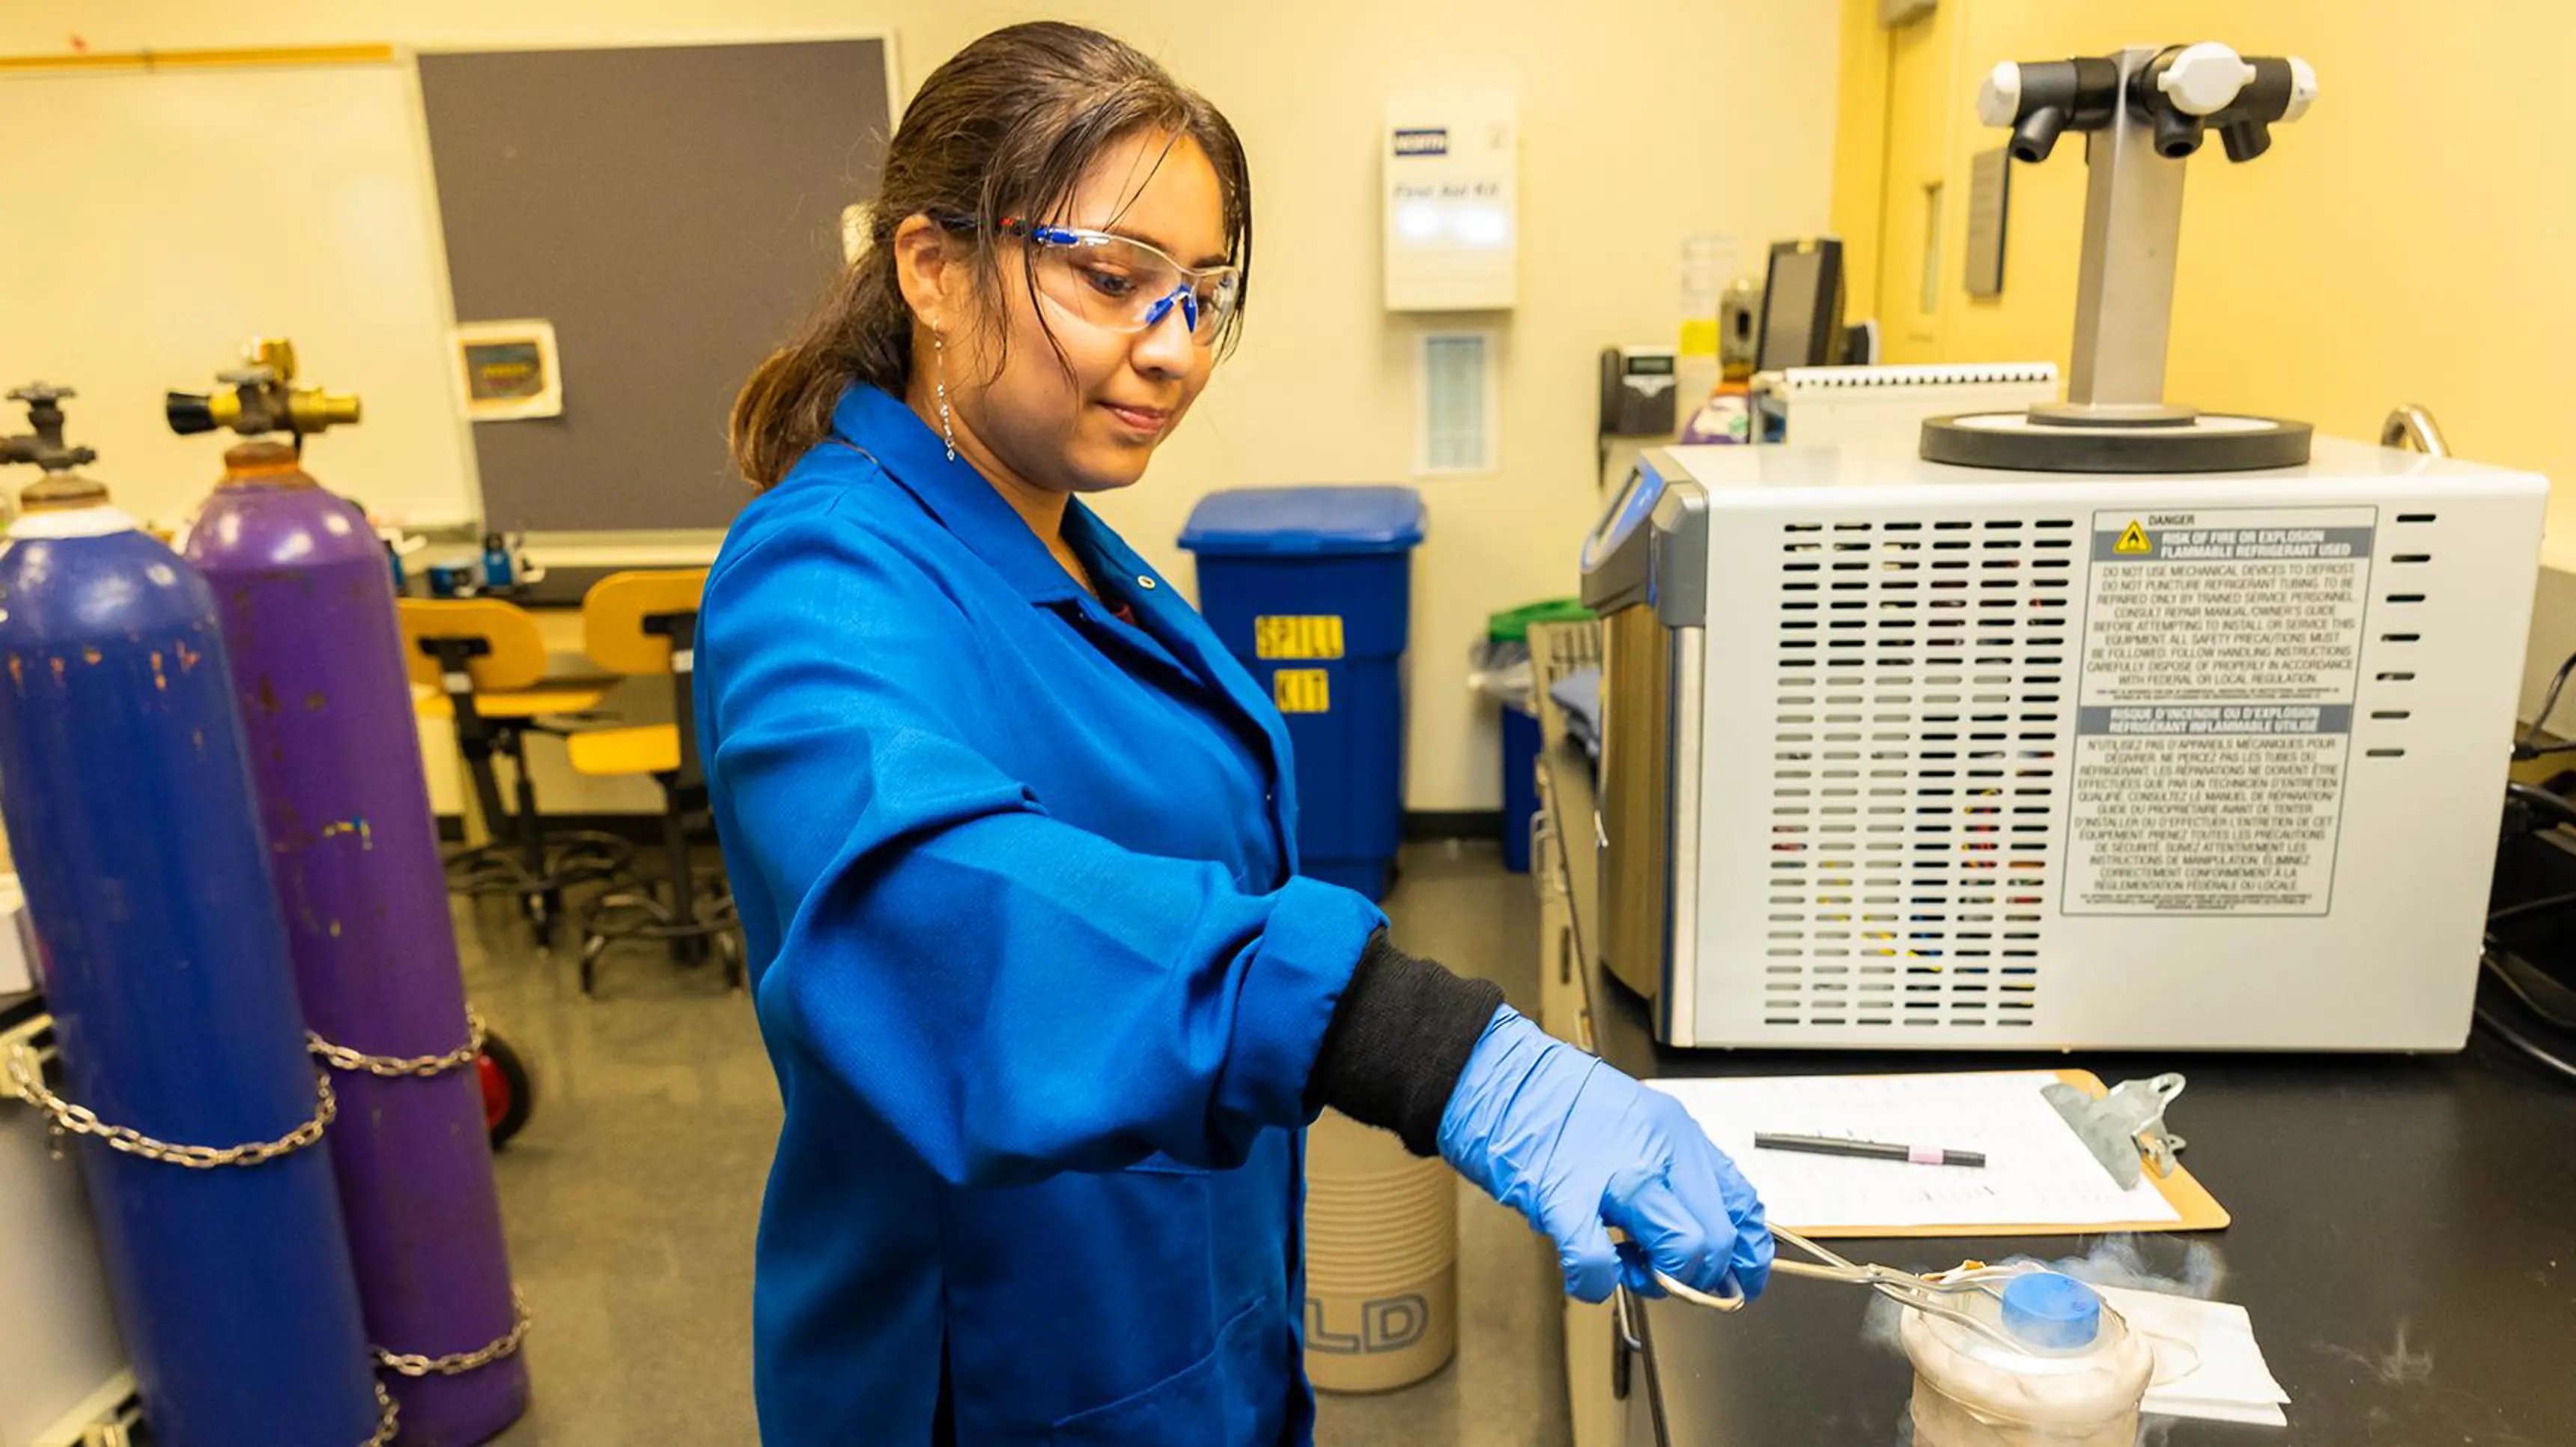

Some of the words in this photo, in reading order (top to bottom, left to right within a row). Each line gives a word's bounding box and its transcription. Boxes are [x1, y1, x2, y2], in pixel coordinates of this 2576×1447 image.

[2147, 515, 2196, 524] DANGER
[2162, 532, 2190, 544] RISK
[2192, 532, 2207, 544] OF
[2210, 532, 2236, 544] FIRE
[2238, 531, 2256, 543] OR
[2258, 530, 2324, 543] EXPLOSION
[2160, 544, 2233, 557] FLAMMABLE
[2235, 544, 2316, 556] REFRIGERANT
[2318, 543, 2351, 556] USED
[2103, 566, 2118, 577] DO
[2121, 566, 2142, 577] NOT
[2145, 565, 2166, 577] USE
[2169, 565, 2237, 576] MECHANICAL
[2241, 565, 2285, 575] DEVICES
[2289, 564, 2303, 575] TO
[2101, 580, 2118, 590] DO
[2120, 580, 2142, 590] NOT
[2145, 579, 2200, 590] PUNCTURE
[2204, 578, 2275, 589] REFRIGERANT
[2324, 577, 2337, 588] TO
[2340, 577, 2353, 588] BE
[2096, 593, 2147, 604] REPAIRED
[2150, 593, 2176, 604] ONLY
[2179, 592, 2193, 604] BY
[2197, 592, 2241, 603] TRAINED
[2244, 592, 2286, 603] SERVICE
[2114, 607, 2161, 618] CONSULT
[2164, 607, 2202, 617] REPAIR
[2304, 605, 2336, 616] GUIDE
[2093, 620, 2133, 631] BEFORE
[2136, 619, 2202, 631] ATTEMPTING
[2205, 619, 2219, 631] TO
[2221, 619, 2261, 630] INSTALL
[2267, 619, 2282, 630] OR
[2285, 619, 2327, 630] SERVICE
[2332, 619, 2355, 629] THIS
[1256, 616, 1343, 658] SPILL
[2169, 634, 2187, 644] ALL
[2191, 633, 2230, 644] SAFETY
[2233, 633, 2306, 643] PRECAUTIONS
[2309, 632, 2339, 643] MUST
[2091, 648, 2103, 658] BE
[2170, 647, 2214, 658] FOLLOW
[2217, 646, 2271, 658] HANDLING
[2273, 646, 2351, 657] INSTRUCTIONS
[2148, 661, 2191, 671] DISPOSE
[2196, 661, 2208, 671] OF
[2211, 660, 2264, 670] PROPERLY
[2267, 660, 2279, 670] IN
[2281, 659, 2353, 670] ACCORDANCE
[2118, 675, 2145, 685] WITH
[2147, 674, 2191, 684] FEDERAL
[2196, 674, 2212, 684] OR
[2214, 674, 2246, 684] LOCAL
[1276, 670, 1326, 711] KIT
[2223, 706, 2240, 720] OU
[2160, 753, 2173, 762] NE
[2300, 752, 2316, 762] DU
[2247, 765, 2261, 775] NE
[2190, 778, 2205, 789] UN
[2189, 791, 2201, 801] LE
[2250, 791, 2264, 801] DE
[2130, 804, 2145, 813] DU
[2256, 804, 2270, 813] DE
[2142, 817, 2156, 827] OU
[2296, 816, 2309, 826] DE
[2094, 843, 2107, 852] DE
[2166, 855, 2178, 865] DE
[2283, 867, 2297, 877] LA
[2240, 880, 2255, 890] OU
